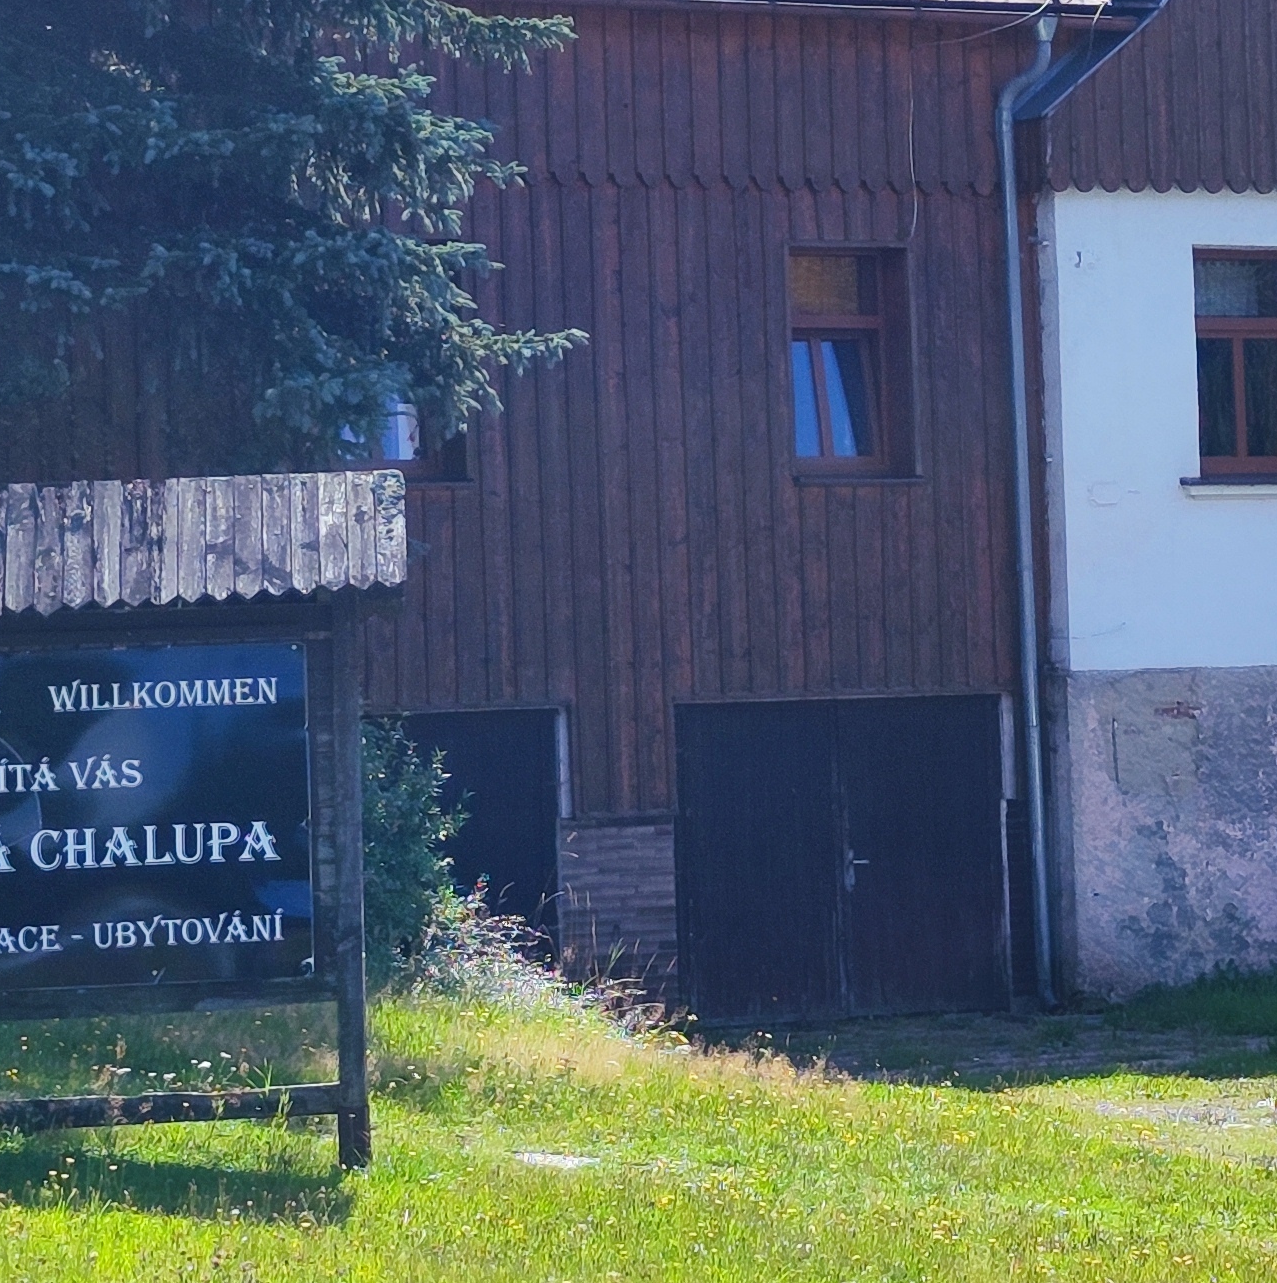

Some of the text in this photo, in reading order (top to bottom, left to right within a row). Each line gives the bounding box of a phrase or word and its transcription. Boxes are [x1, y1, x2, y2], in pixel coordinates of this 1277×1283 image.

[48, 677, 278, 712] WILLKOMMEN
[69, 754, 143, 790] VÁS
[30, 821, 281, 871] CHALUPA
[93, 908, 285, 949] UBYTOVÁNÍ
